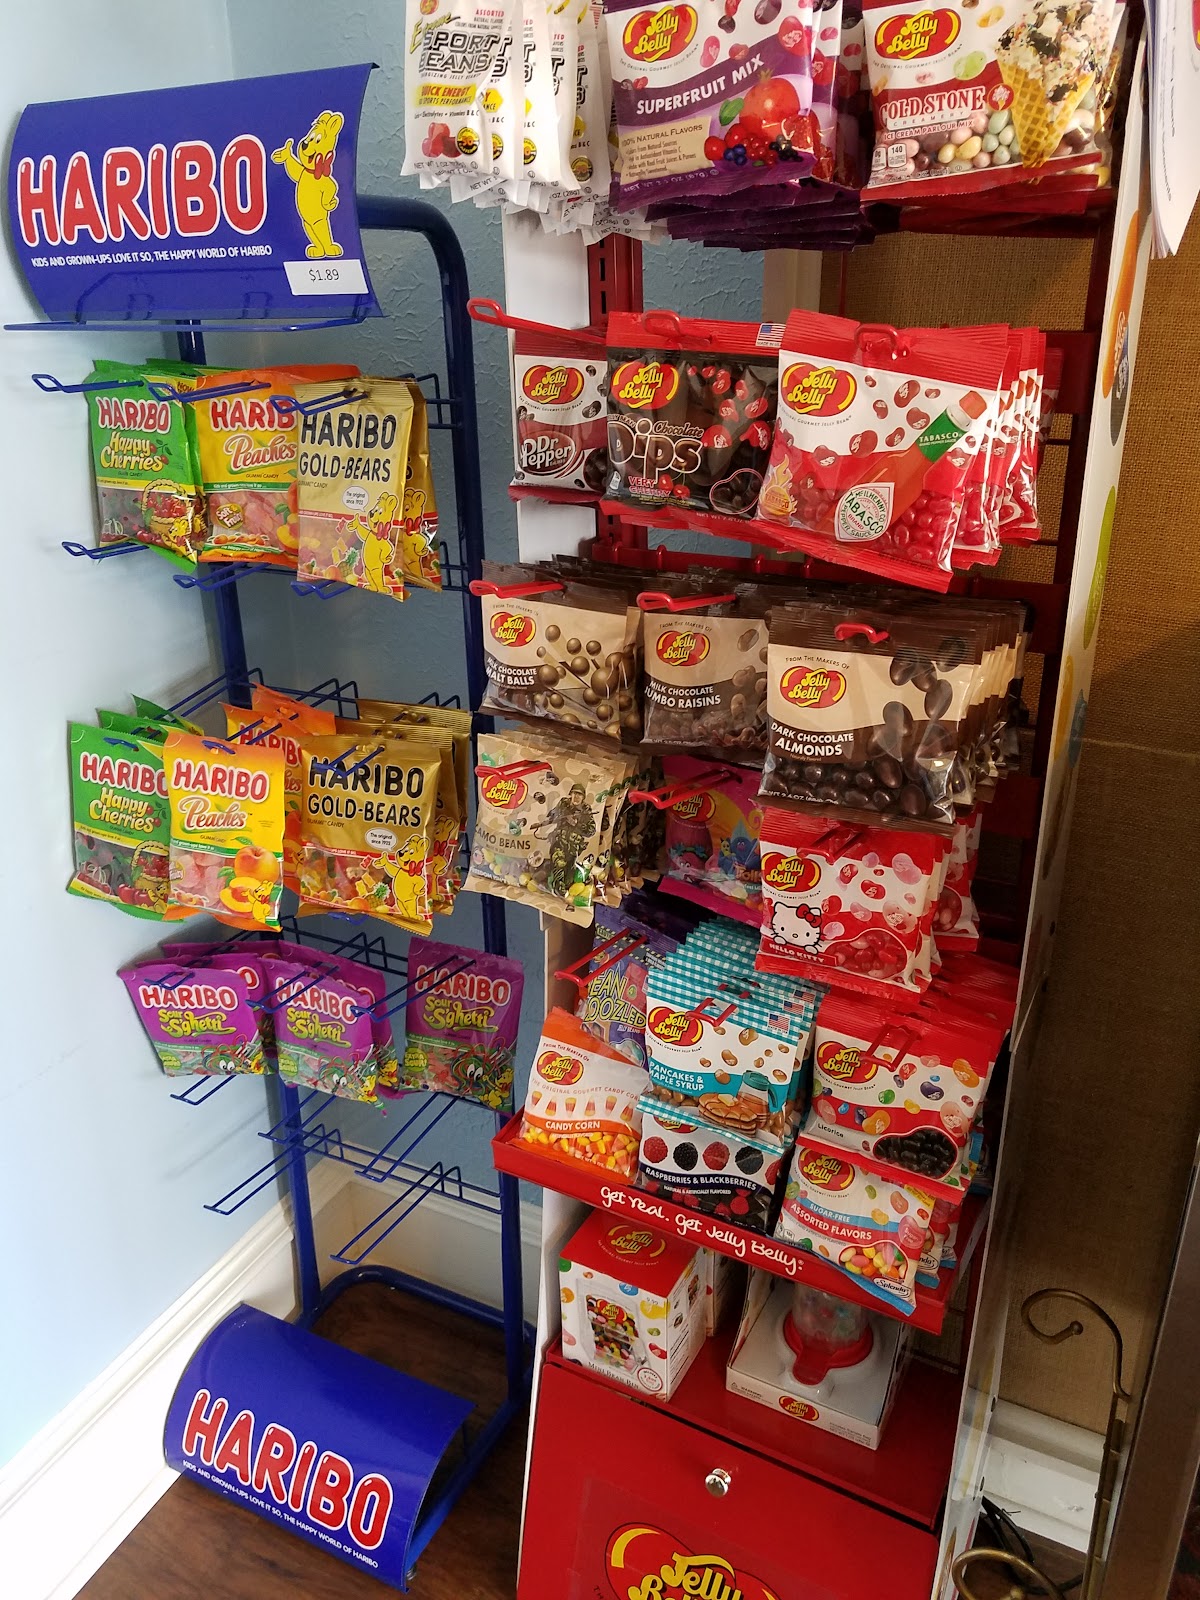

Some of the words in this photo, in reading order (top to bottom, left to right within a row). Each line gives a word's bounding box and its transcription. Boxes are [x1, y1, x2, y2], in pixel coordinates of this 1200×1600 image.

[646, 6, 679, 36] Jelly
[901, 10, 938, 36] Jelly
[422, 29, 502, 54] SPORT
[633, 33, 672, 62] Belly
[886, 33, 930, 61] Belly
[441, 86, 471, 97] ENERGY
[636, 76, 726, 115] SUPERFRUIT
[731, 53, 765, 85] MIX
[893, 111, 965, 127] CREAMERY
[895, 129, 920, 139] CREAM
[921, 123, 956, 134] PARLOUR
[958, 119, 974, 128] MIX
[636, 131, 669, 143] NATURAL
[670, 124, 703, 136] FLAVORS
[891, 145, 903, 154] 140
[17, 133, 268, 248] HARIBO
[31, 256, 49, 268] KIDS
[49, 255, 66, 267] AND
[66, 253, 112, 266] GROWN-UPS
[112, 252, 133, 264] LOVE
[139, 251, 154, 264] SO,
[153, 250, 171, 262] THE
[170, 249, 197, 261] HAPPY
[196, 247, 228, 260] WORLD
[227, 246, 240, 258] OF
[240, 244, 273, 257] HARIBO
[308, 268, 340, 283] $1.89
[542, 365, 568, 387] Jelly
[632, 361, 664, 389] Jelly
[802, 366, 838, 394] Jelly
[530, 381, 562, 405] Belly
[618, 381, 656, 409] Belly
[787, 383, 827, 415] Belly
[95, 397, 171, 434] HARIBO
[210, 398, 298, 432] HARIB
[301, 411, 398, 450] HARIBO
[653, 420, 704, 439] Chocolate
[918, 431, 960, 443] TABASCO
[109, 431, 152, 457] Happy
[224, 434, 298, 471] Peaches
[520, 437, 573, 470] Pepper
[537, 435, 559, 453] Dr
[607, 417, 703, 485] Dips
[101, 445, 165, 473] Cherries
[299, 451, 392, 484] GOLD-BEARS
[628, 475, 656, 488] VERY
[628, 485, 671, 497] CHERRY
[844, 490, 884, 534] TABASCO
[847, 513, 865, 531] BRAND
[502, 613, 526, 633] Jelly
[494, 626, 519, 647] Belly
[672, 630, 697, 651] Jelly
[486, 656, 499, 671] MILK
[498, 666, 538, 676] CHOCOLATE
[662, 645, 691, 667] Belly
[815, 656, 840, 667] MAKERS
[841, 661, 850, 670] OF
[485, 666, 506, 683] MALT
[506, 675, 535, 686] BALLS
[801, 667, 831, 691] Jelly
[644, 685, 676, 708] JUMBO
[678, 694, 721, 709] RAISINS
[649, 680, 667, 694] MILK
[667, 685, 714, 697] CHOCOLATE
[788, 683, 822, 708] Belly
[770, 722, 797, 739] DARK
[797, 732, 855, 744] CHOCOLATE
[774, 736, 843, 757] ALMONDS
[80, 751, 169, 800] HARIBO
[172, 757, 270, 804] HARIBO
[308, 756, 425, 800] HARIBO
[496, 778, 518, 795] Jelly
[99, 786, 150, 818] Happy
[486, 786, 513, 808] Belly
[88, 799, 155, 834] Cherries
[177, 795, 249, 831] Peaches
[307, 793, 422, 828] GOLD-BEARS
[672, 801, 699, 820] Belly
[326, 820, 345, 828] CANDY
[499, 838, 531, 850] BEANS
[776, 855, 805, 876] Jelly
[765, 868, 798, 891] Belly
[769, 943, 796, 956] HELLO
[796, 950, 825, 963] KITTY
[415, 964, 511, 1007] HARIBO
[588, 968, 629, 1000] EAN
[138, 984, 239, 1012] HARIBO
[275, 976, 358, 1025] HARIBO
[425, 995, 453, 1012] Sour
[157, 1008, 183, 1023] Sour
[286, 1006, 312, 1023] Sour
[423, 1001, 500, 1033] S'ghetti
[584, 996, 647, 1029] OOZLED
[664, 1011, 690, 1032] Jelly
[160, 1011, 238, 1039] S'ghetti
[654, 1021, 683, 1044] Belly
[541, 1065, 567, 1083] Belly
[551, 1055, 574, 1073] Jelly
[648, 1060, 695, 1083] PANCAKES
[695, 1075, 704, 1085] &
[823, 1057, 855, 1080] Belly
[542, 1083, 570, 1095] ORIGINAL
[604, 1086, 625, 1095] CANDY
[675, 1079, 705, 1092] SYRUP
[545, 1120, 573, 1131] CANDY
[574, 1120, 601, 1130] CORN
[817, 1123, 844, 1138] Licorice
[803, 1162, 833, 1184] Belly
[815, 1154, 841, 1175] Jelly
[645, 1166, 691, 1184] RASPBERRIES
[692, 1176, 699, 1185] &
[700, 1176, 757, 1191] BLACKBERRIES
[790, 1203, 830, 1231] ASSORTED
[830, 1225, 873, 1240] FLAVORS
[809, 1203, 851, 1223] SUGAR-FREE
[625, 1230, 653, 1247] Jelly
[629, 1196, 670, 1222] real.
[705, 1224, 747, 1258] Jelly
[610, 1235, 643, 1255] Belly
[875, 1279, 910, 1295] Splenda
[625, 1379, 640, 1390] BIN
[182, 1388, 394, 1551] HARIBO
[182, 1459, 197, 1473] KIDS
[197, 1467, 211, 1480] AND
[211, 1474, 249, 1500] GROWN-UPS
[249, 1494, 266, 1508] LOVE
[271, 1506, 284, 1519] SO,
[283, 1512, 297, 1525] THE
[296, 1518, 318, 1537] HAPPY
[318, 1530, 343, 1549] WORLD
[342, 1545, 353, 1556] OF
[353, 1550, 379, 1569] HARIBO
